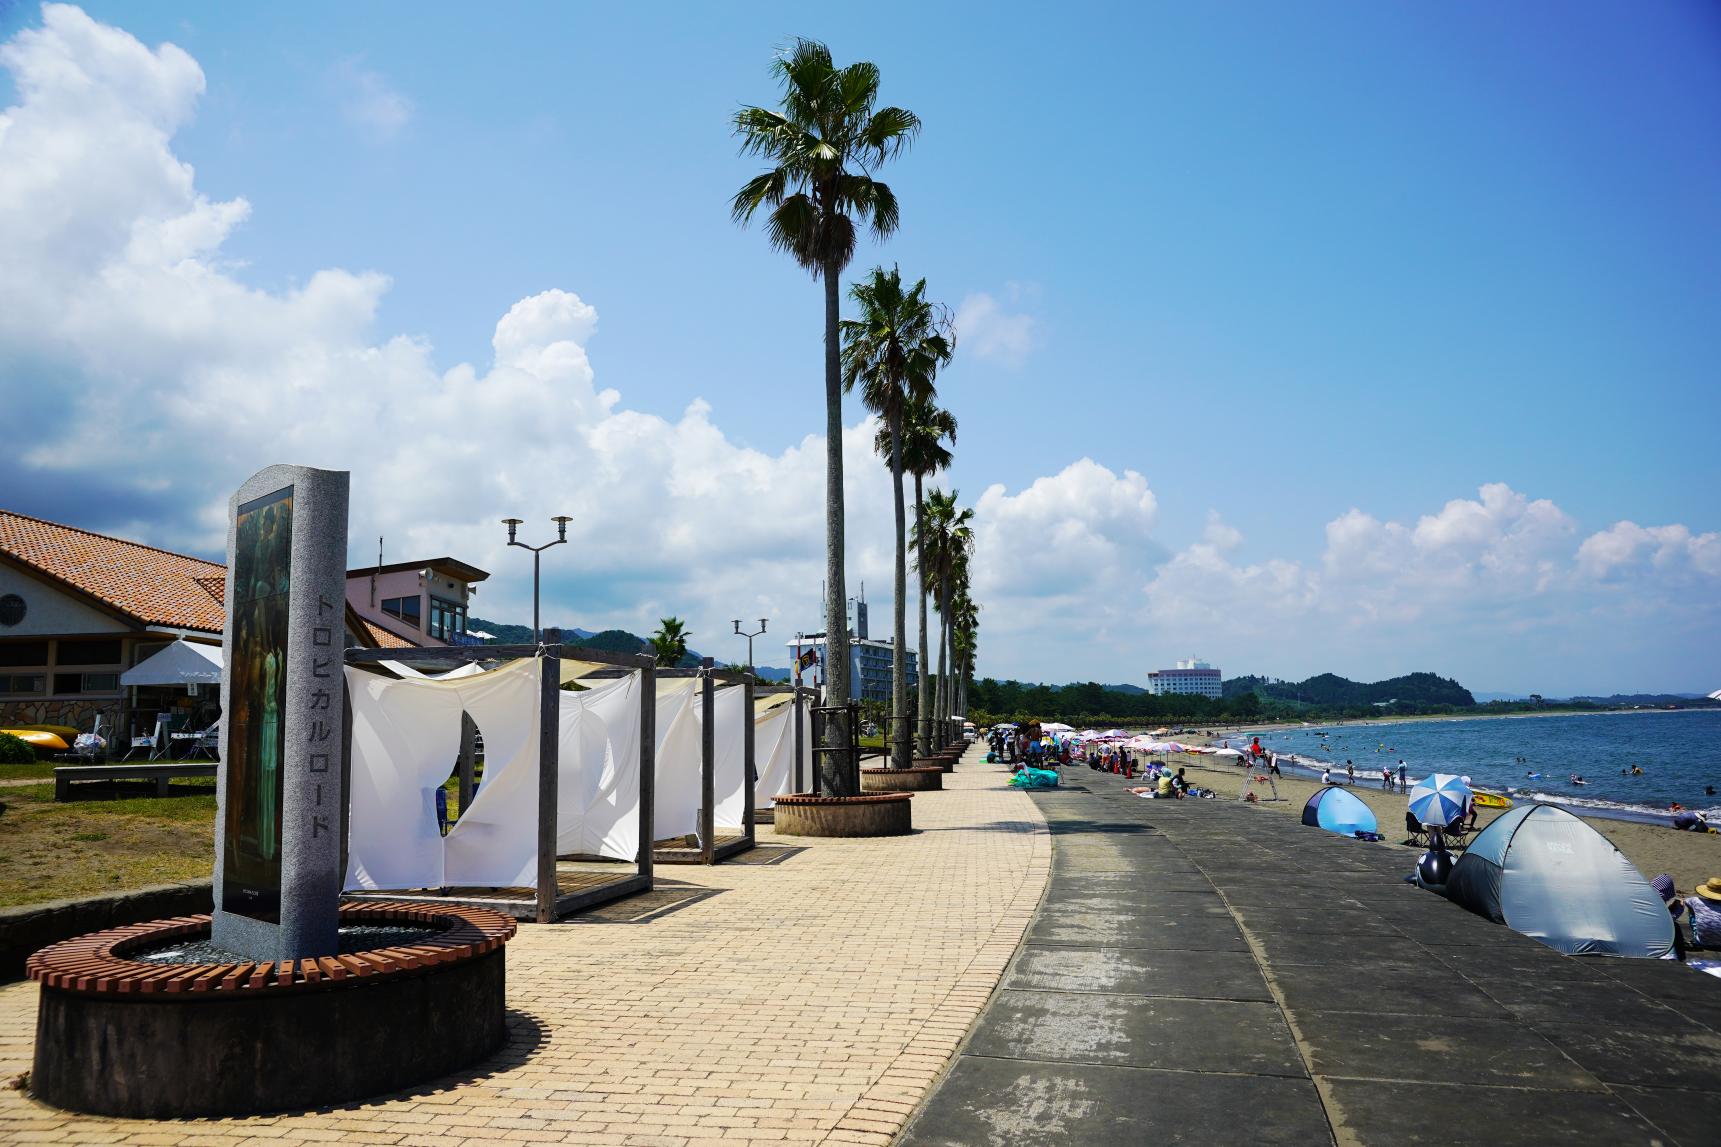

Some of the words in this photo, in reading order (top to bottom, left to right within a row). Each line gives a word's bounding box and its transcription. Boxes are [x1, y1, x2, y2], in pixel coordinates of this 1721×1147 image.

[309, 594, 333, 838] トロピカルロード
